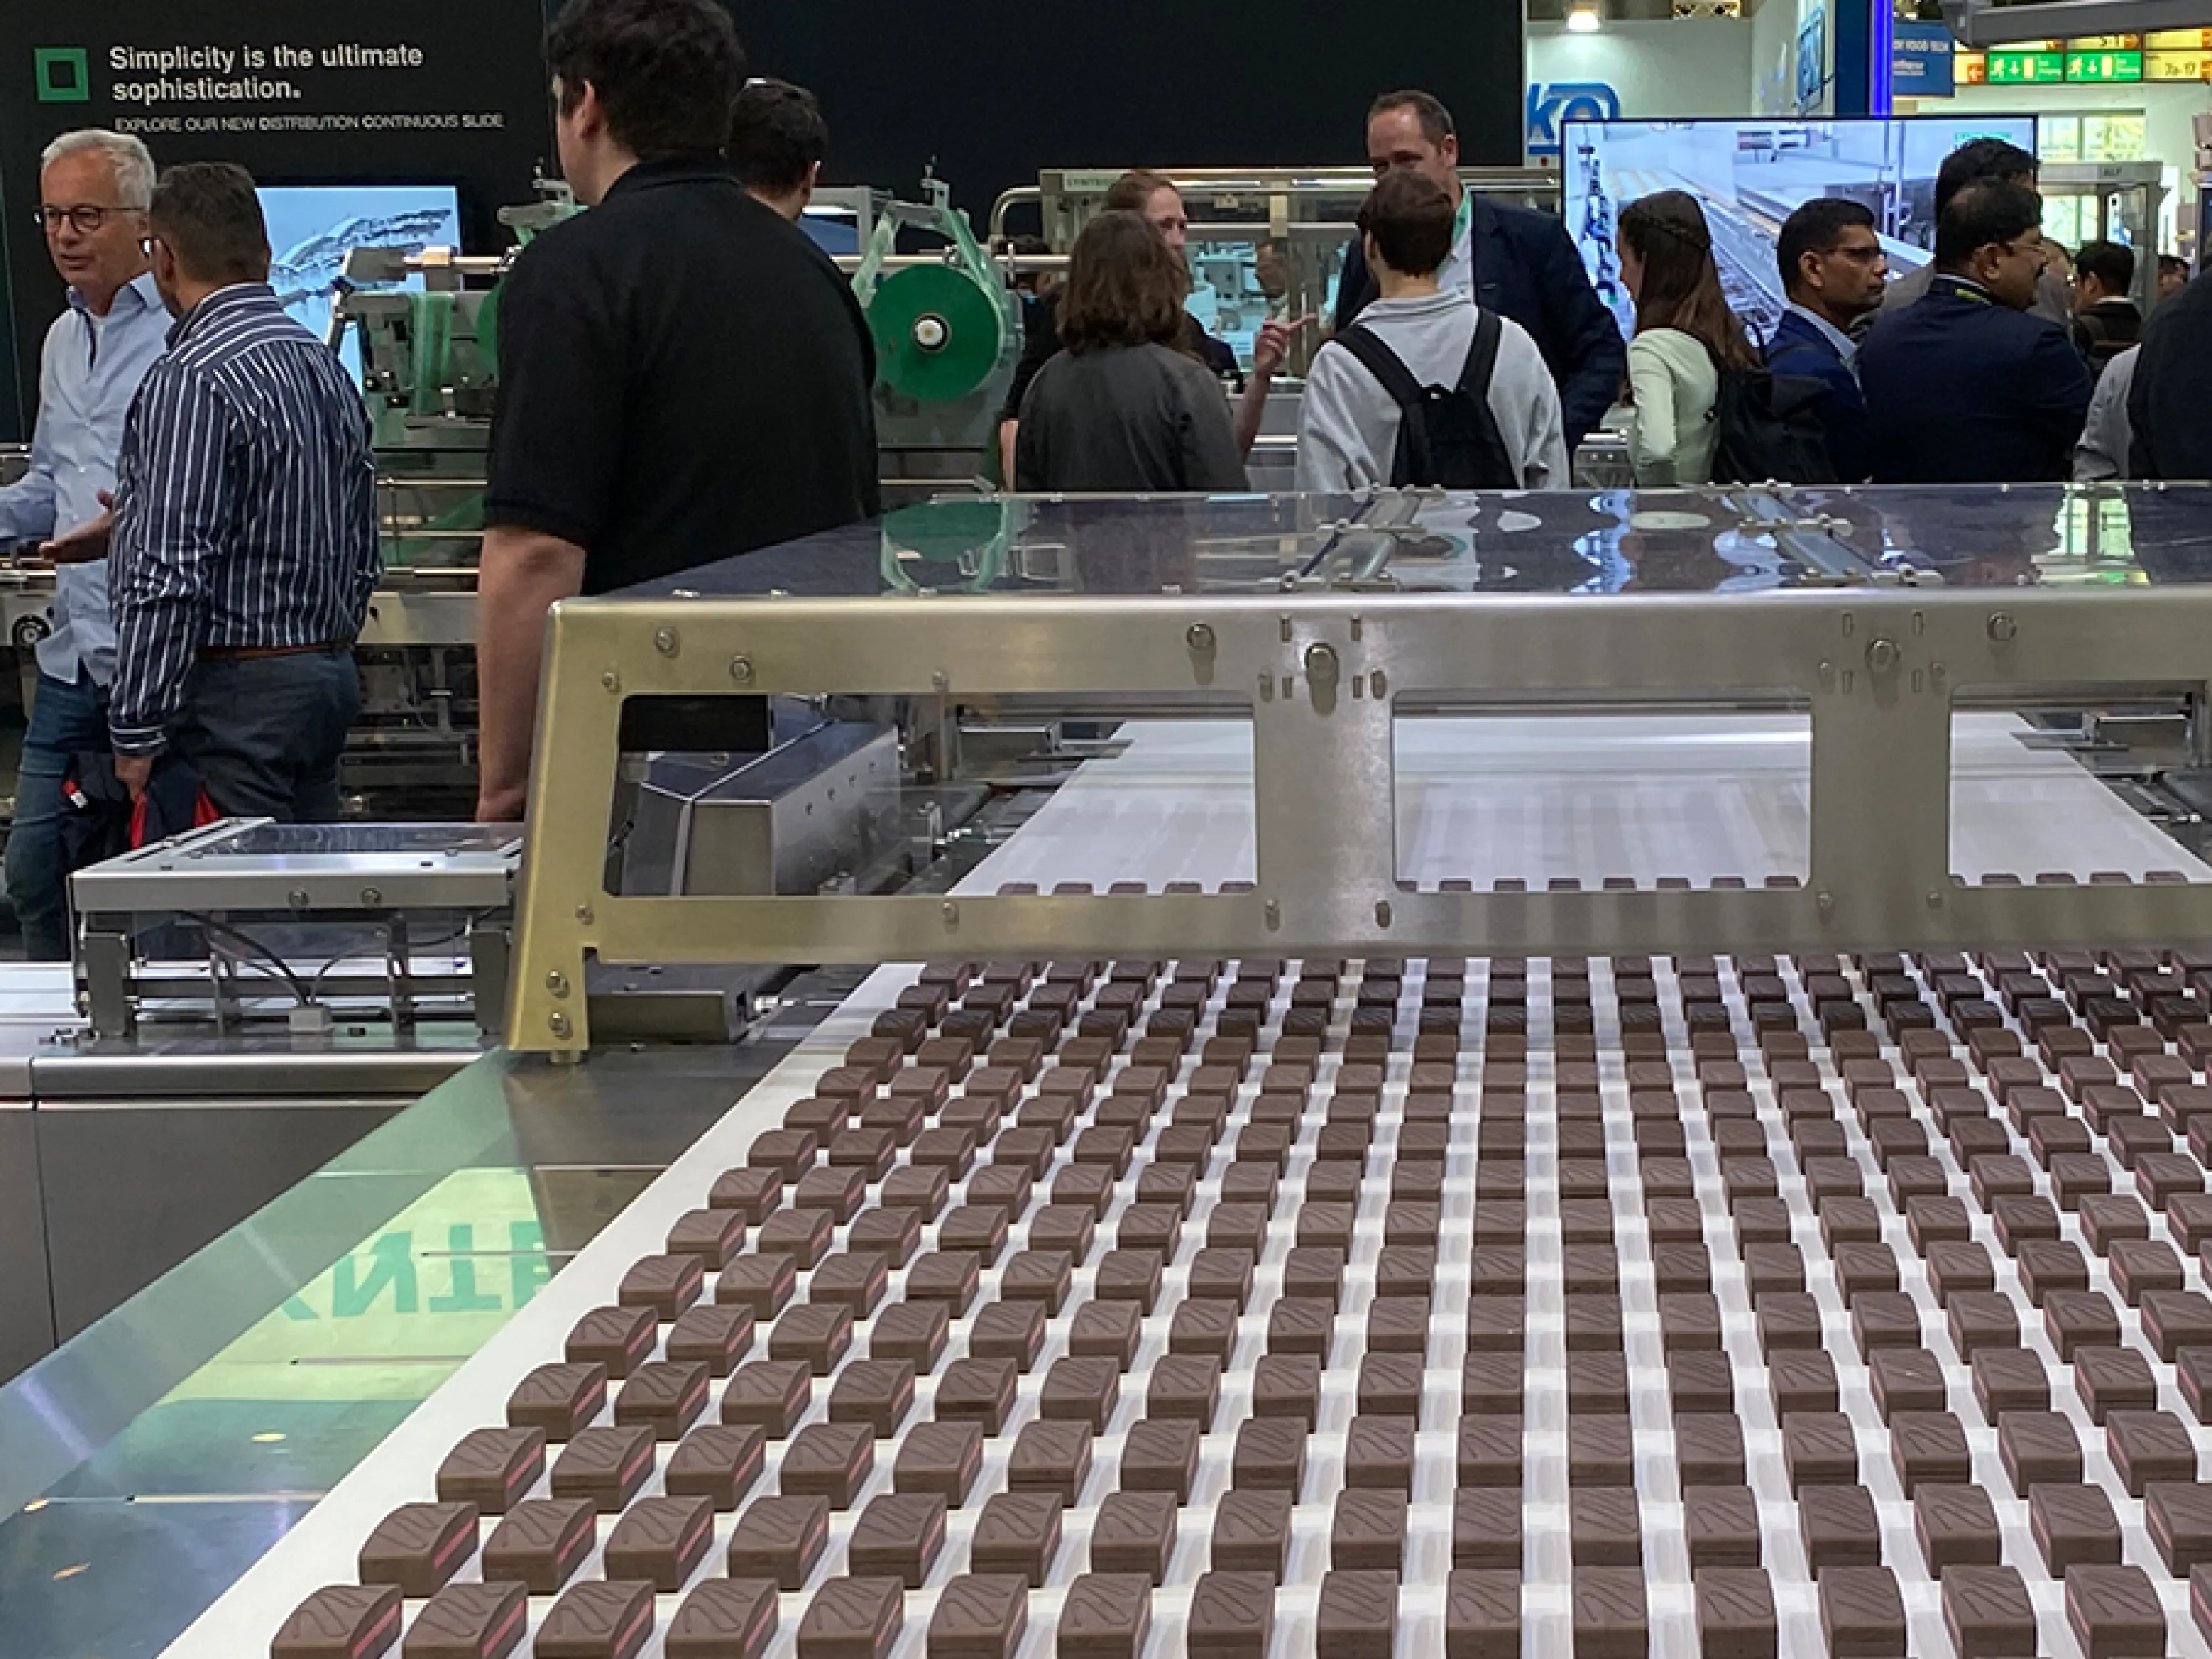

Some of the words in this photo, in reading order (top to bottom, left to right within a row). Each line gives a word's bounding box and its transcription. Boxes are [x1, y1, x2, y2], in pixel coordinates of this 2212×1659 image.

[110, 46, 235, 74] Simplicity
[243, 43, 266, 69] is
[274, 44, 313, 67] the
[321, 43, 424, 67] ultimate
[112, 75, 302, 105] sophistication.
[114, 117, 182, 132] EXPLORE
[185, 117, 218, 131] OUR
[222, 116, 255, 130] NEW
[259, 115, 358, 130] DISTRIBUTION
[361, 114, 459, 129] CONTINUOUS
[461, 112, 504, 128] SLIDE
